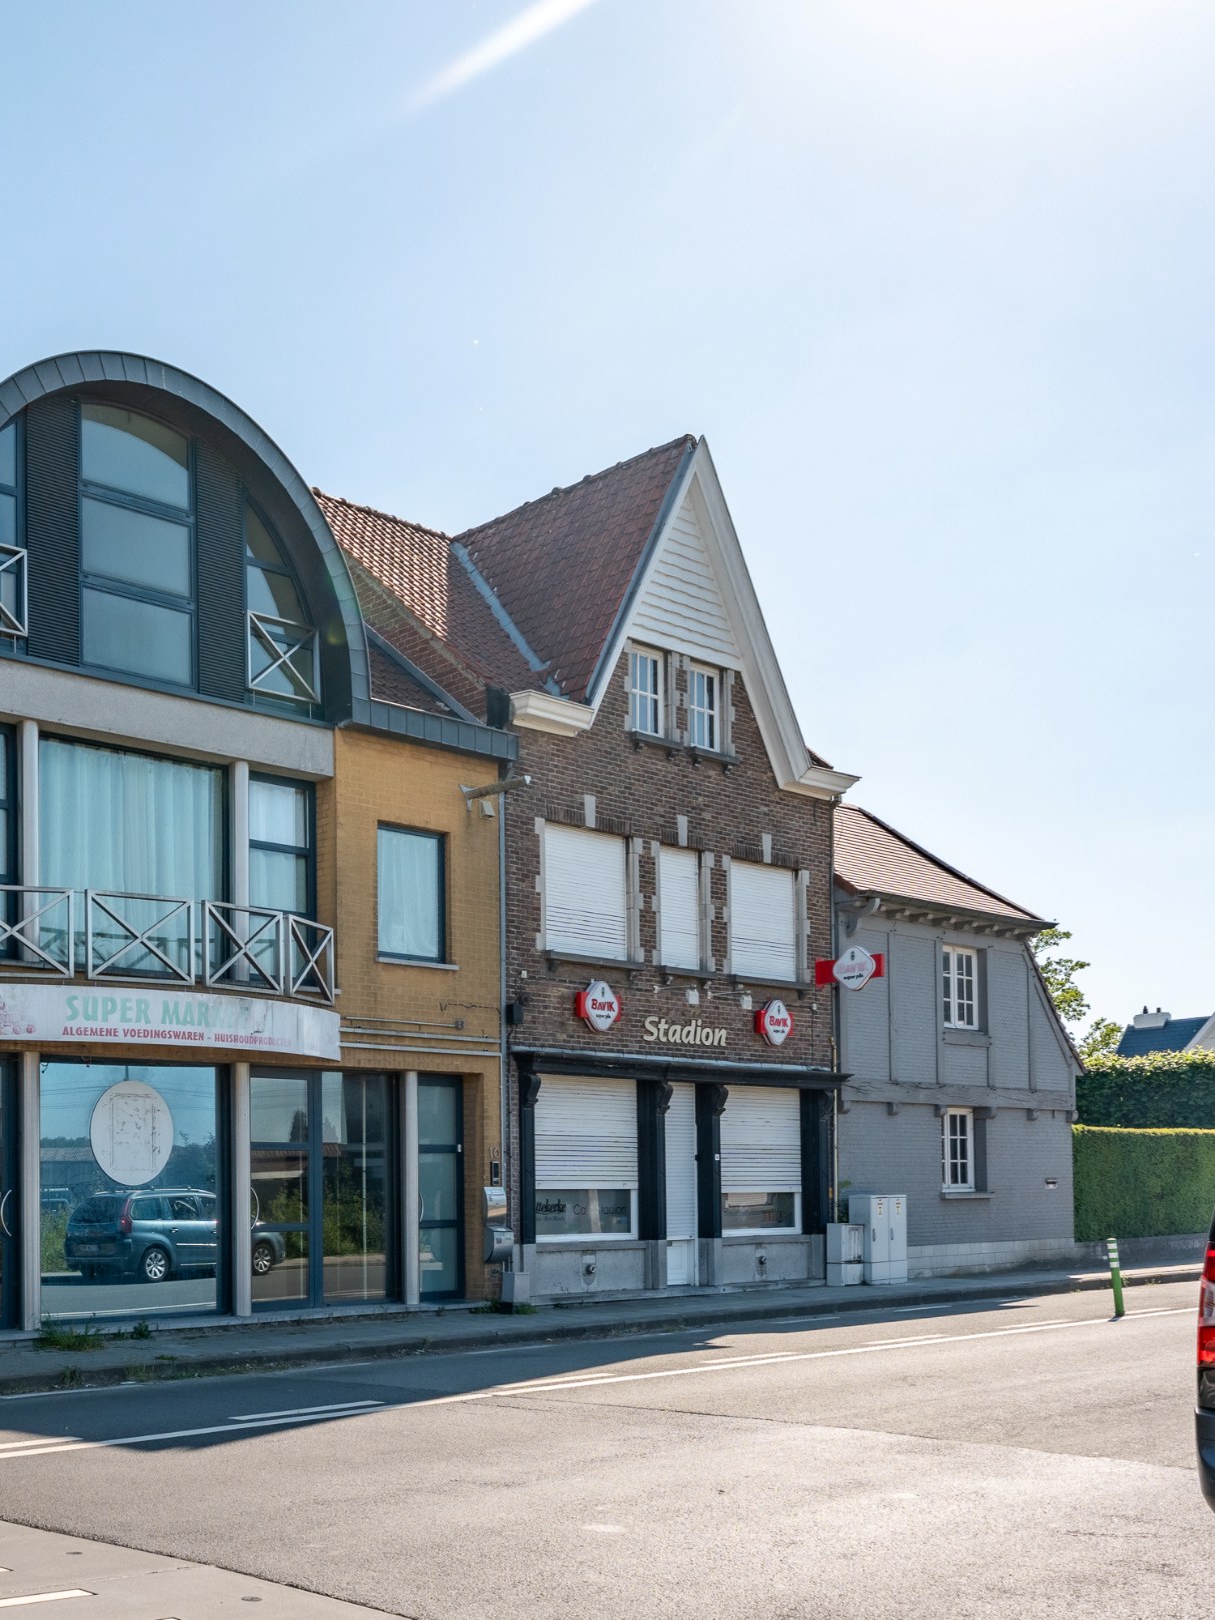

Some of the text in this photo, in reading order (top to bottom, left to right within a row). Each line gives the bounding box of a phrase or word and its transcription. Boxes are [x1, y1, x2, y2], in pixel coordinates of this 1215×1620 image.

[65, 995, 151, 1024] SUPER
[591, 998, 615, 1012] BAVIK
[62, 1026, 119, 1037] ALGEMENE
[123, 1028, 204, 1041] VOEDINGSWAREN
[643, 1016, 727, 1046] Stadion
